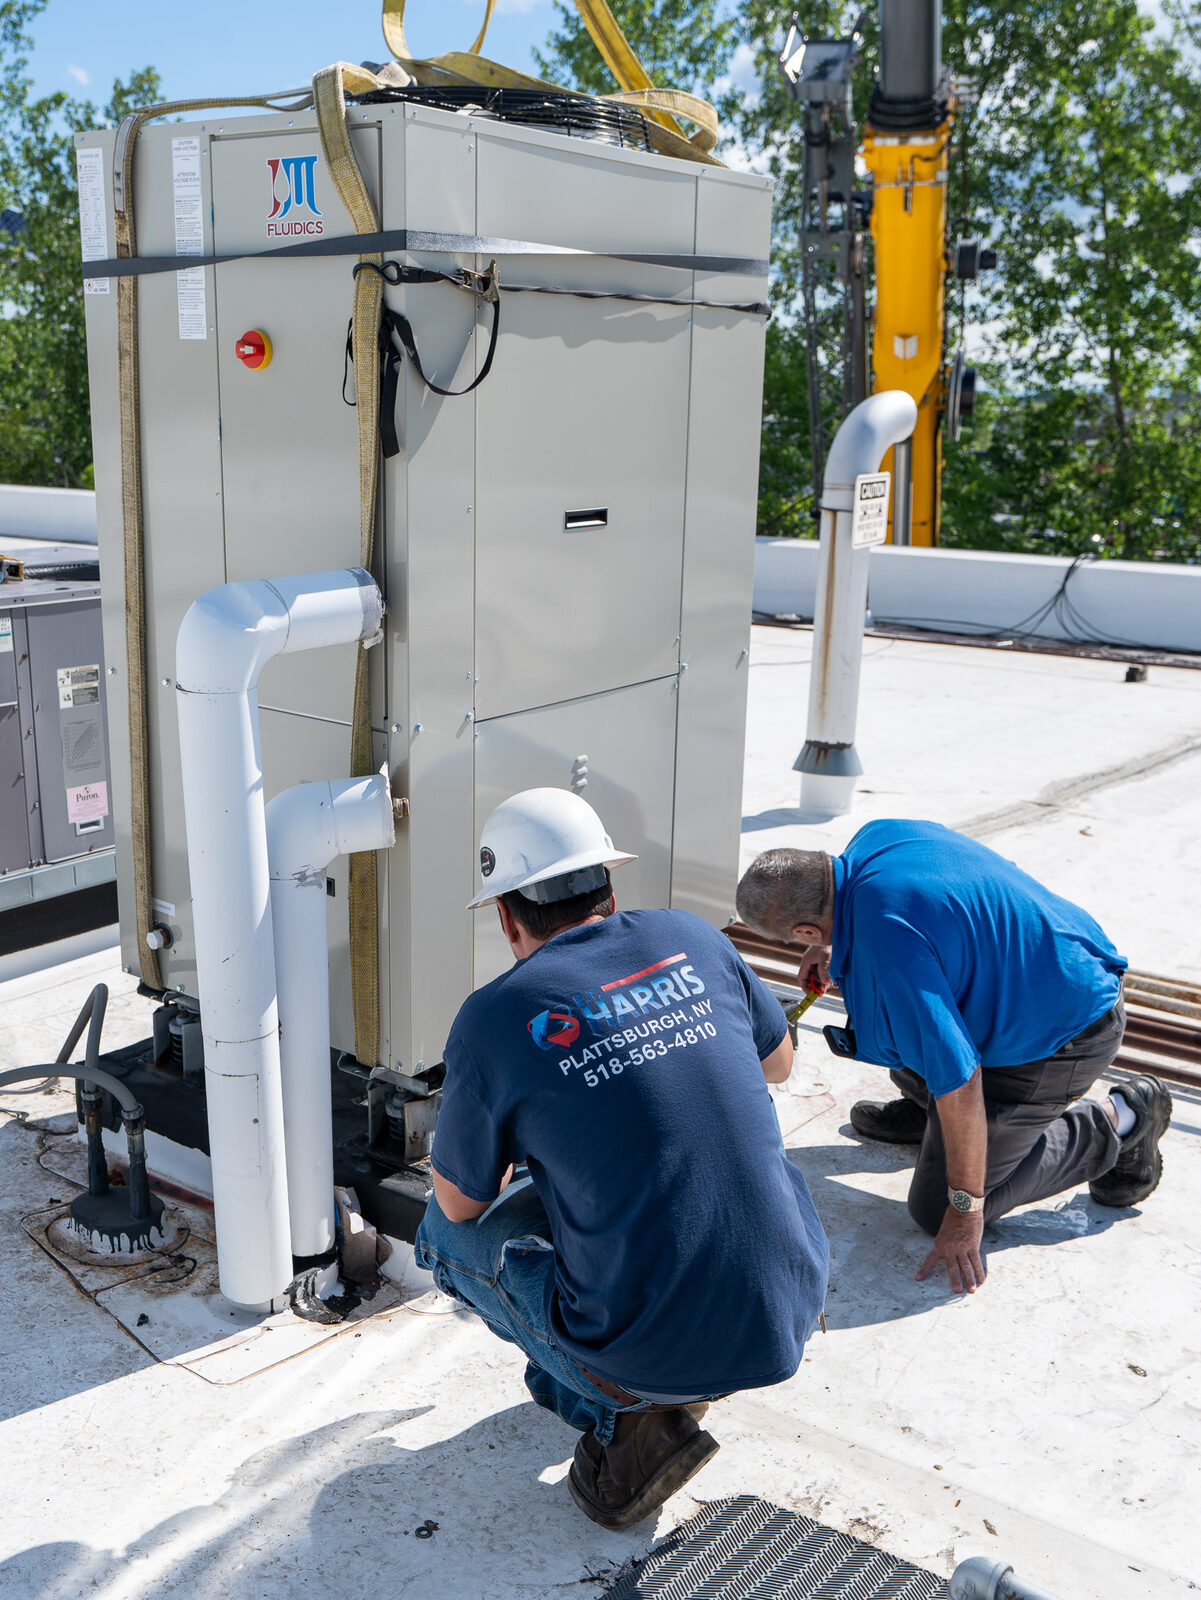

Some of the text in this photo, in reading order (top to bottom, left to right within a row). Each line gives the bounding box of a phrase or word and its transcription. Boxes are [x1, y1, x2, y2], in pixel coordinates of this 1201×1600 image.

[267, 221, 324, 236] FLUIDICS
[861, 482, 885, 499] CAUTION
[581, 965, 705, 1035] HARRIS
[558, 999, 713, 1076] PLATTSBURGH, NY
[583, 1021, 717, 1088] 518-563-4810
